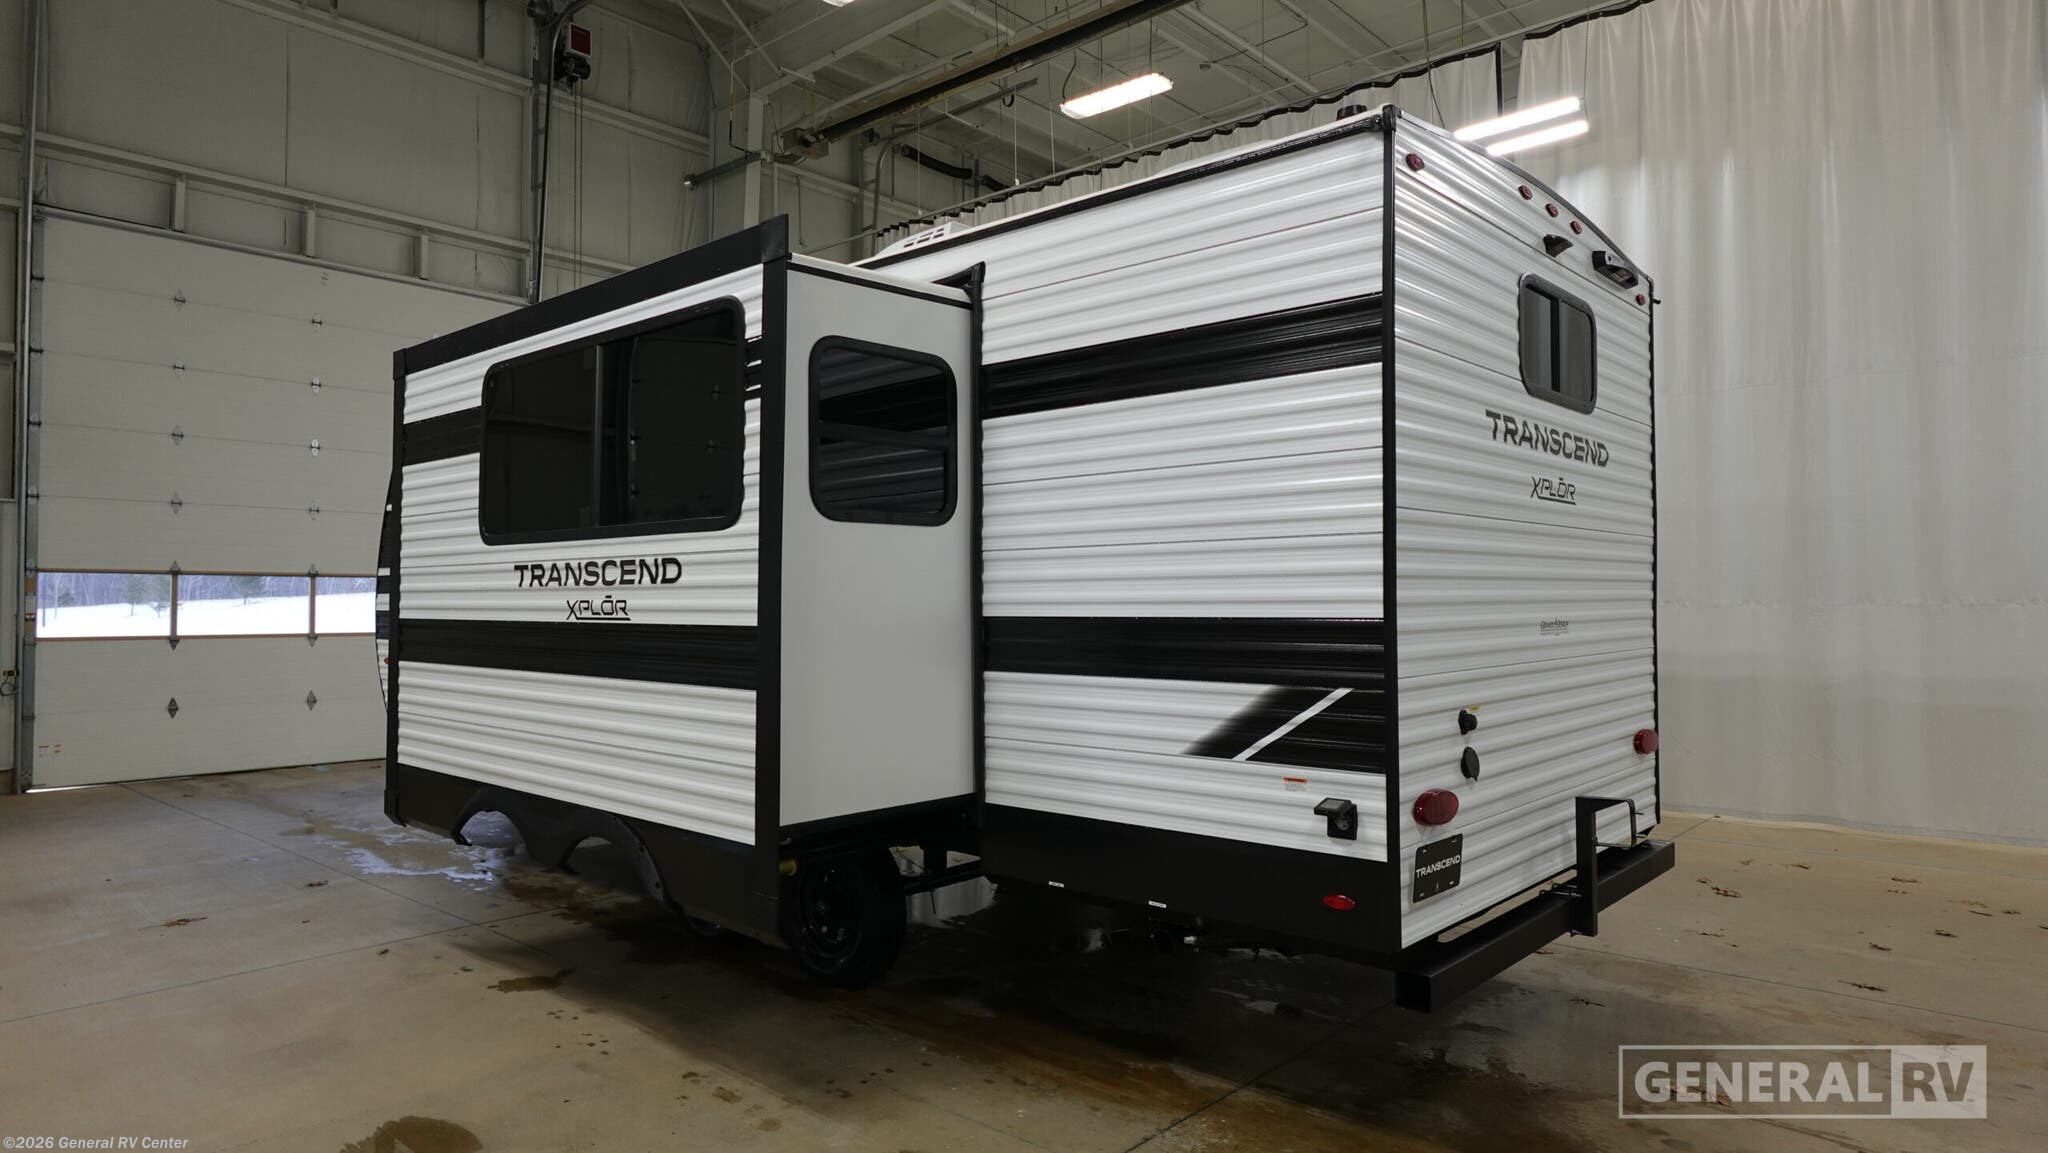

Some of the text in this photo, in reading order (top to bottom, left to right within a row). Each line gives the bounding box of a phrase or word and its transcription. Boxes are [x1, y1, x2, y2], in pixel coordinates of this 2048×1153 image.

[1485, 408, 1609, 468] TRANSCEND
[514, 557, 682, 588] TRANSCEND
[1415, 854, 1461, 878] TRANSCEND
